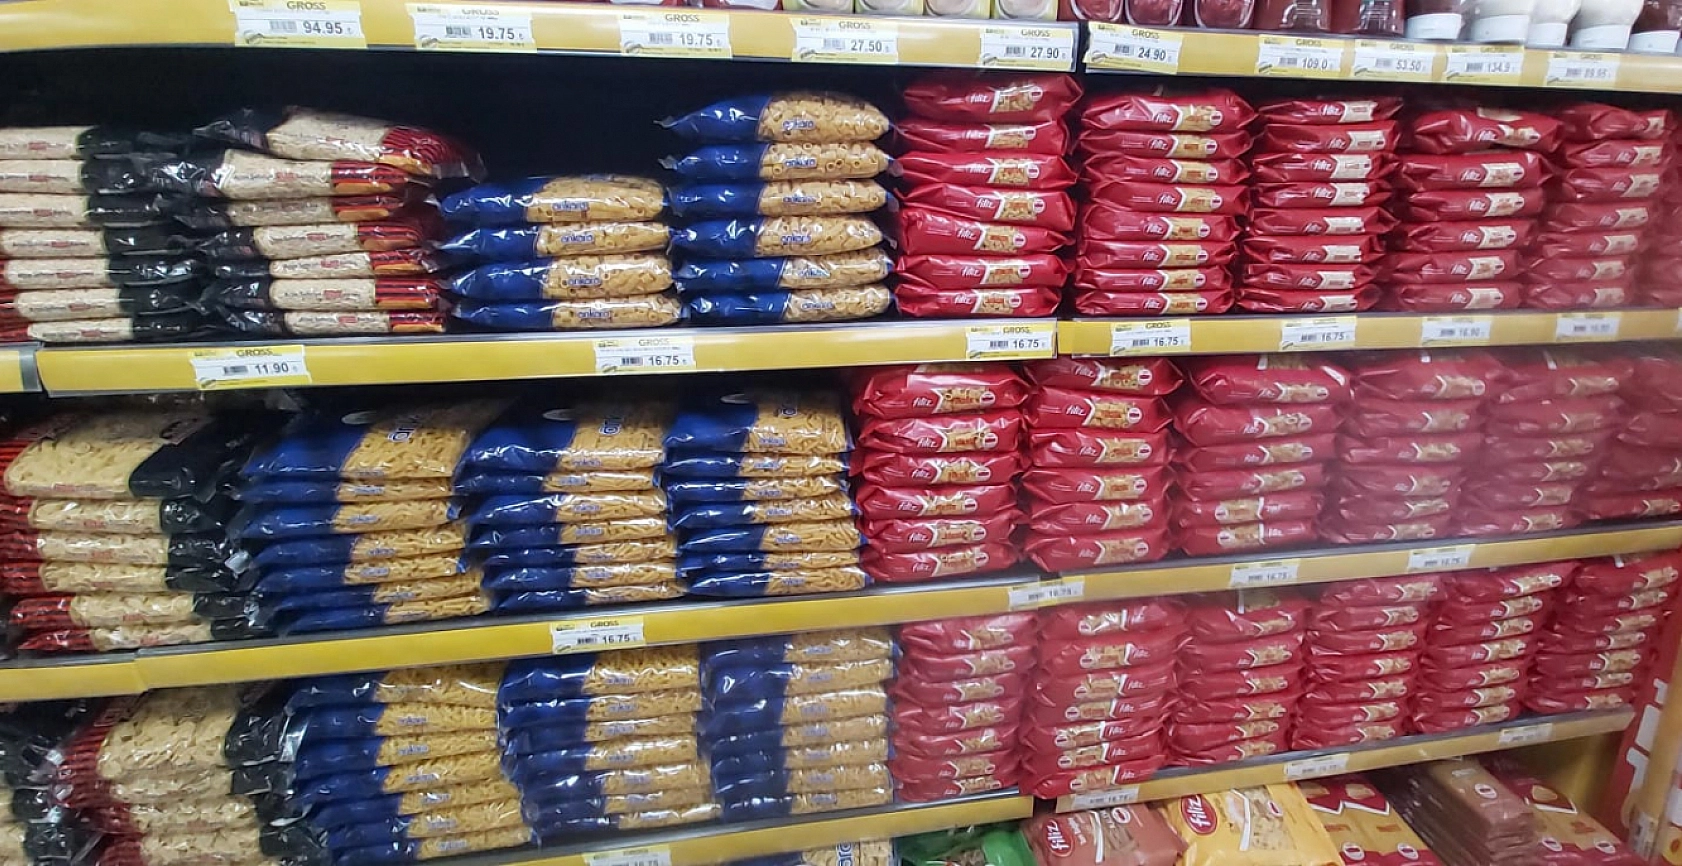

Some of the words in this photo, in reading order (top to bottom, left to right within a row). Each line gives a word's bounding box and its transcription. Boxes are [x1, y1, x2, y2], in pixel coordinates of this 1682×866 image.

[286, 0, 326, 11] GROSS
[664, 14, 699, 22] GROSS
[303, 20, 342, 34] 94.95
[838, 21, 871, 30] GROSS
[478, 27, 515, 40] 19.75
[679, 33, 712, 46] 19.75
[851, 40, 882, 53] 27.50
[1030, 46, 1059, 59] 27.90
[1138, 47, 1167, 62] 24.90
[976, 198, 995, 209] filiz
[958, 229, 977, 241] filiz
[961, 266, 980, 277] filiz
[954, 294, 973, 305] filiz
[638, 338, 670, 346] GROSS
[1153, 336, 1179, 347] 16.75
[1321, 331, 1345, 342] 16.75
[1012, 339, 1039, 349] 16.75
[236, 348, 273, 358] GROSS
[648, 355, 679, 366] 16.75
[255, 362, 289, 375] 11.90
[1076, 365, 1095, 378] filiz
[912, 396, 933, 407] filiz
[1066, 404, 1086, 417] filiz
[917, 437, 939, 449] filiz
[912, 468, 931, 479] filiz
[898, 503, 918, 512] filiz
[909, 532, 927, 543] filiz
[913, 562, 931, 572] filiz
[602, 634, 630, 644] 16.75
[1187, 793, 1211, 827] filiz
[1047, 820, 1069, 850] filiz
